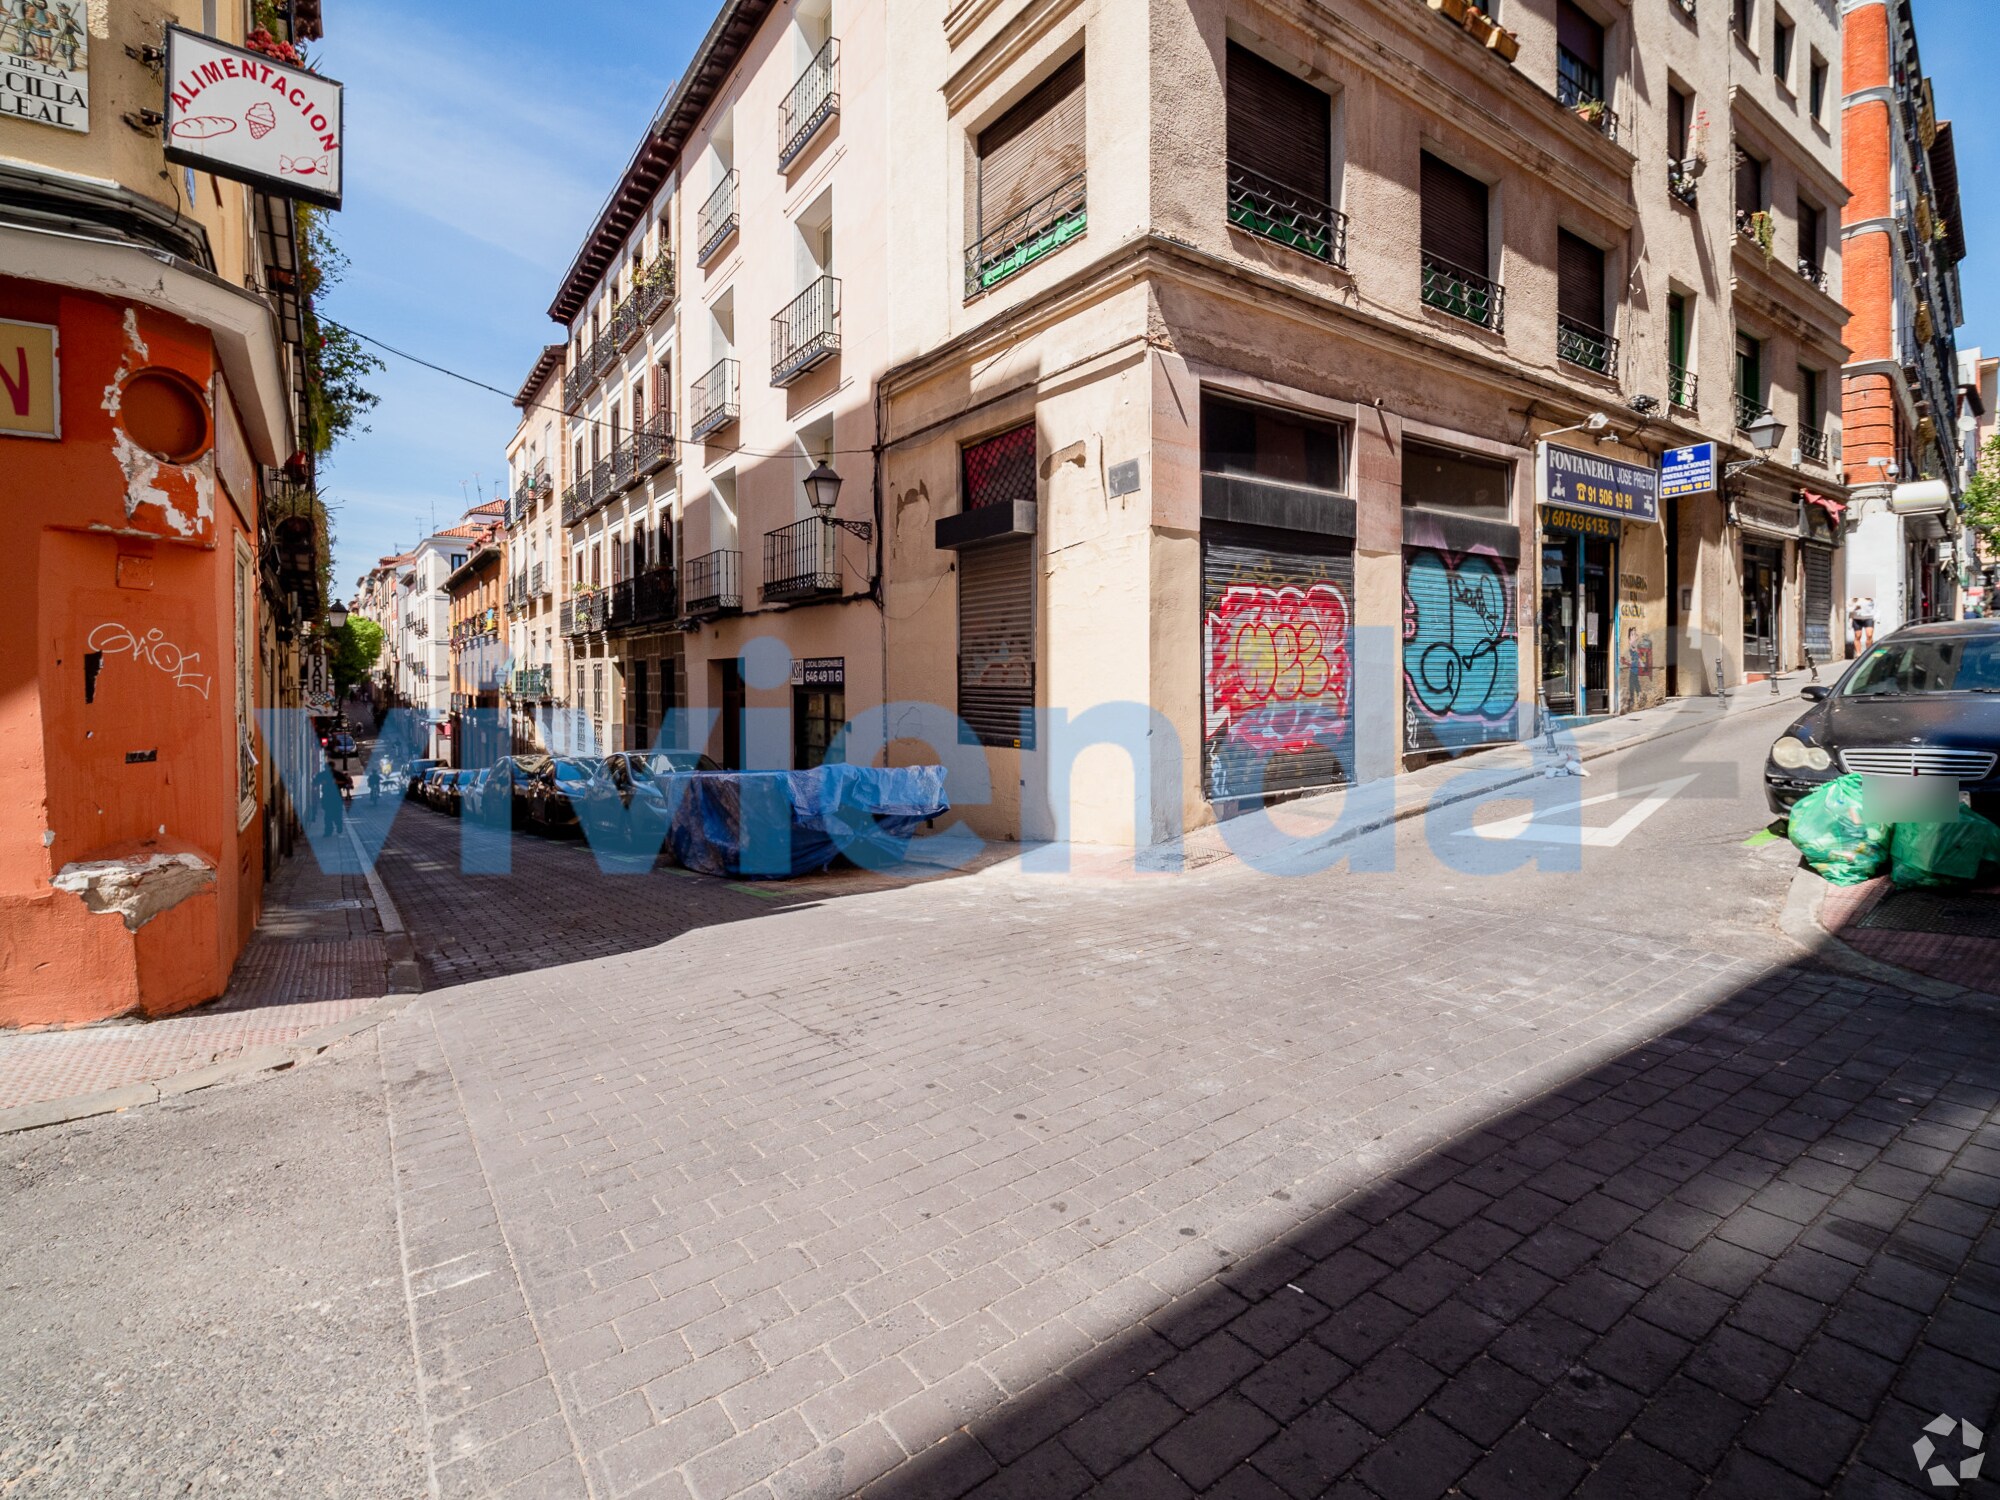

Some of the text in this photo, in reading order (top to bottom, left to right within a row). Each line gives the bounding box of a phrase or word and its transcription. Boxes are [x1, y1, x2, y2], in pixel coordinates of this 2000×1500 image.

[8, 55, 69, 80] DE LA
[0, 71, 88, 109] CILLA
[0, 92, 74, 127] LEAL
[170, 57, 341, 153] ALIMENTACION
[1549, 449, 1654, 491] FONTANERIA JOSE PRIETO
[1662, 459, 1710, 474] REPARACIONES
[1662, 467, 1710, 481] INSTALACIONES
[1587, 485, 1597, 503] 91
[1599, 488, 1613, 507] 506
[1624, 494, 1633, 510] 51
[1552, 510, 1609, 536] 607696133
[312, 655, 323, 692] BAR
[805, 659, 843, 668] LOCAL DISPONIBLE
[805, 670, 818, 682] 646
[818, 670, 828, 682] 49
[828, 670, 834, 682] 11
[834, 670, 843, 682] 61
